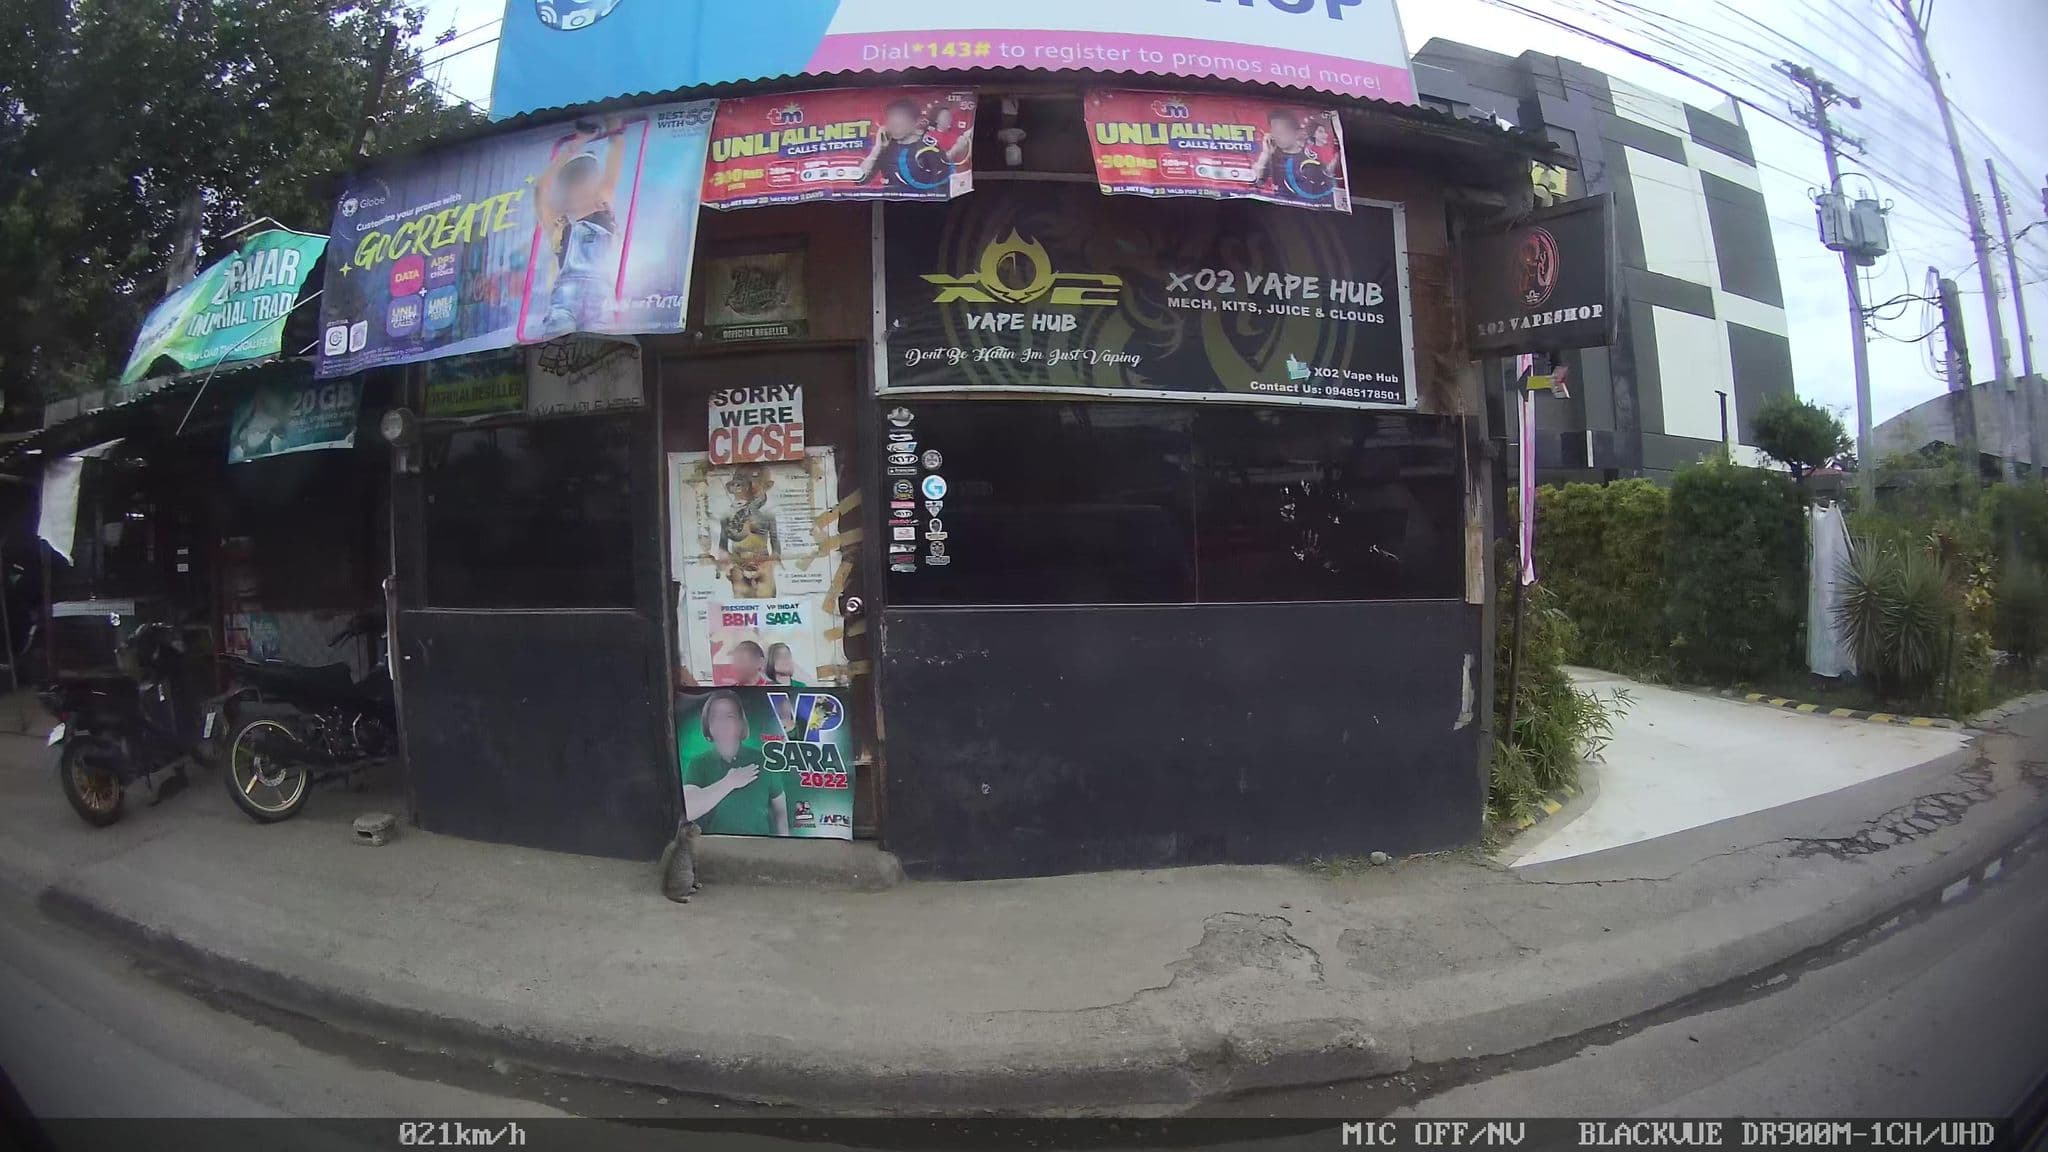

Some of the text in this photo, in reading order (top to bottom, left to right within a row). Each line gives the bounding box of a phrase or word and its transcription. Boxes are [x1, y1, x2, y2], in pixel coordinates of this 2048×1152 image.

[1000, 42, 1025, 58] to
[1035, 43, 1131, 62] register
[1139, 47, 1163, 63] to
[1173, 52, 1262, 74] promos
[1270, 63, 1311, 80] and
[1320, 70, 1382, 91] more!
[1096, 122, 1168, 145] UNLI
[712, 133, 781, 163] UNLI
[787, 144, 820, 155] CALLS
[1178, 140, 1208, 150] CALLS
[356, 192, 462, 232] Customize your promo with
[360, 197, 386, 211] Globe
[395, 269, 419, 283] DATA
[1166, 268, 1384, 307] XO2 VAPE HUB
[1168, 297, 1385, 324] MECH, KITS, JUICE & CLOUDS
[1509, 304, 1603, 331] VAPESHOP
[723, 326, 788, 339] OFFICIAL RESELLER
[966, 312, 1078, 332] VAPE HUB
[905, 346, 1143, 367] Dont Be Hatin Im Just Vaping
[1314, 368, 1399, 384] XO2 Vape Hub
[713, 384, 800, 407] SORRY
[1250, 380, 1400, 401] Contact Us: 09485178501
[720, 406, 794, 428] WERE
[710, 422, 804, 465] CLOSE
[721, 604, 760, 612] PRESIDENT
[722, 612, 758, 627] BBM
[765, 611, 802, 626] SARA
[767, 692, 844, 743] VP
[762, 741, 848, 774] SARA
[800, 772, 849, 789] 2022
